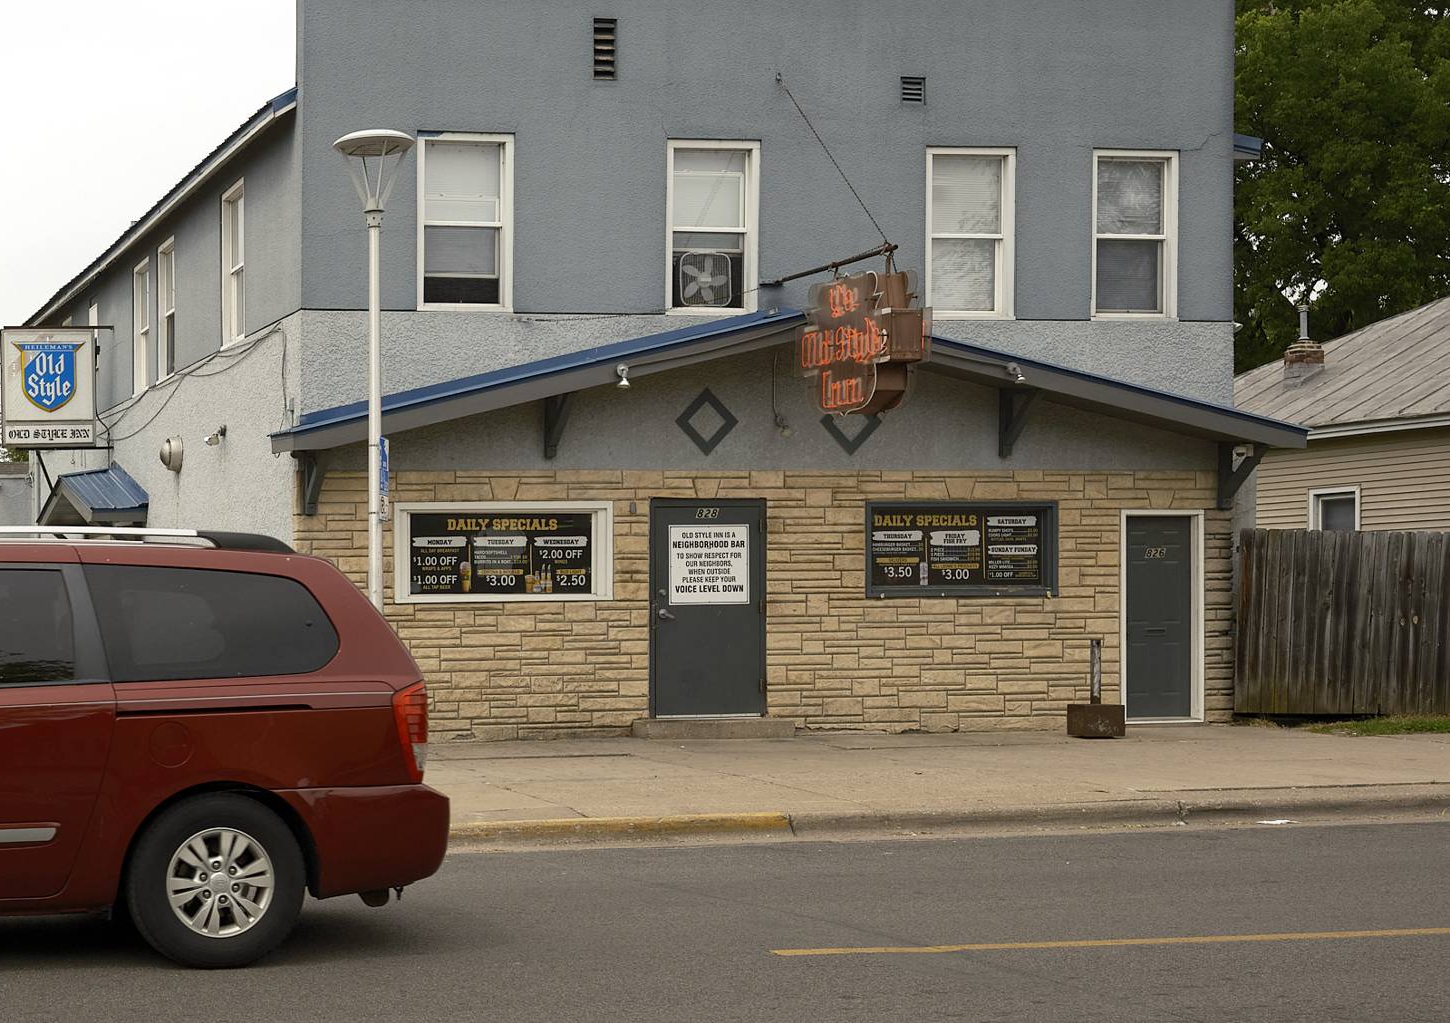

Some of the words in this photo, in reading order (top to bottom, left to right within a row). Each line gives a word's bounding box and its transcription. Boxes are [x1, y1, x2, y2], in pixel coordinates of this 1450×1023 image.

[35, 352, 64, 376] Old
[28, 374, 71, 405] Style
[8, 429, 30, 439] OLD
[33, 429, 68, 440] STYLE
[70, 429, 90, 439] INN
[697, 508, 718, 518] 828
[446, 518, 490, 531] DAILY
[492, 518, 558, 531] SPECIALS
[874, 515, 914, 526] DAILY
[916, 515, 978, 526] SPECIALS
[673, 540, 728, 549] NEIGHBORHOOD
[539, 550, 563, 558] $2.00
[565, 550, 583, 558] OFF
[1146, 548, 1165, 558] 826
[413, 557, 437, 566] $1.00
[440, 557, 458, 566] OFF
[884, 566, 912, 577] $3.50
[942, 569, 970, 580] $3.00
[413, 575, 437, 584] $1.00
[440, 575, 458, 584] OFF
[486, 575, 515, 586] $3.00
[556, 575, 586, 586] $2.50
